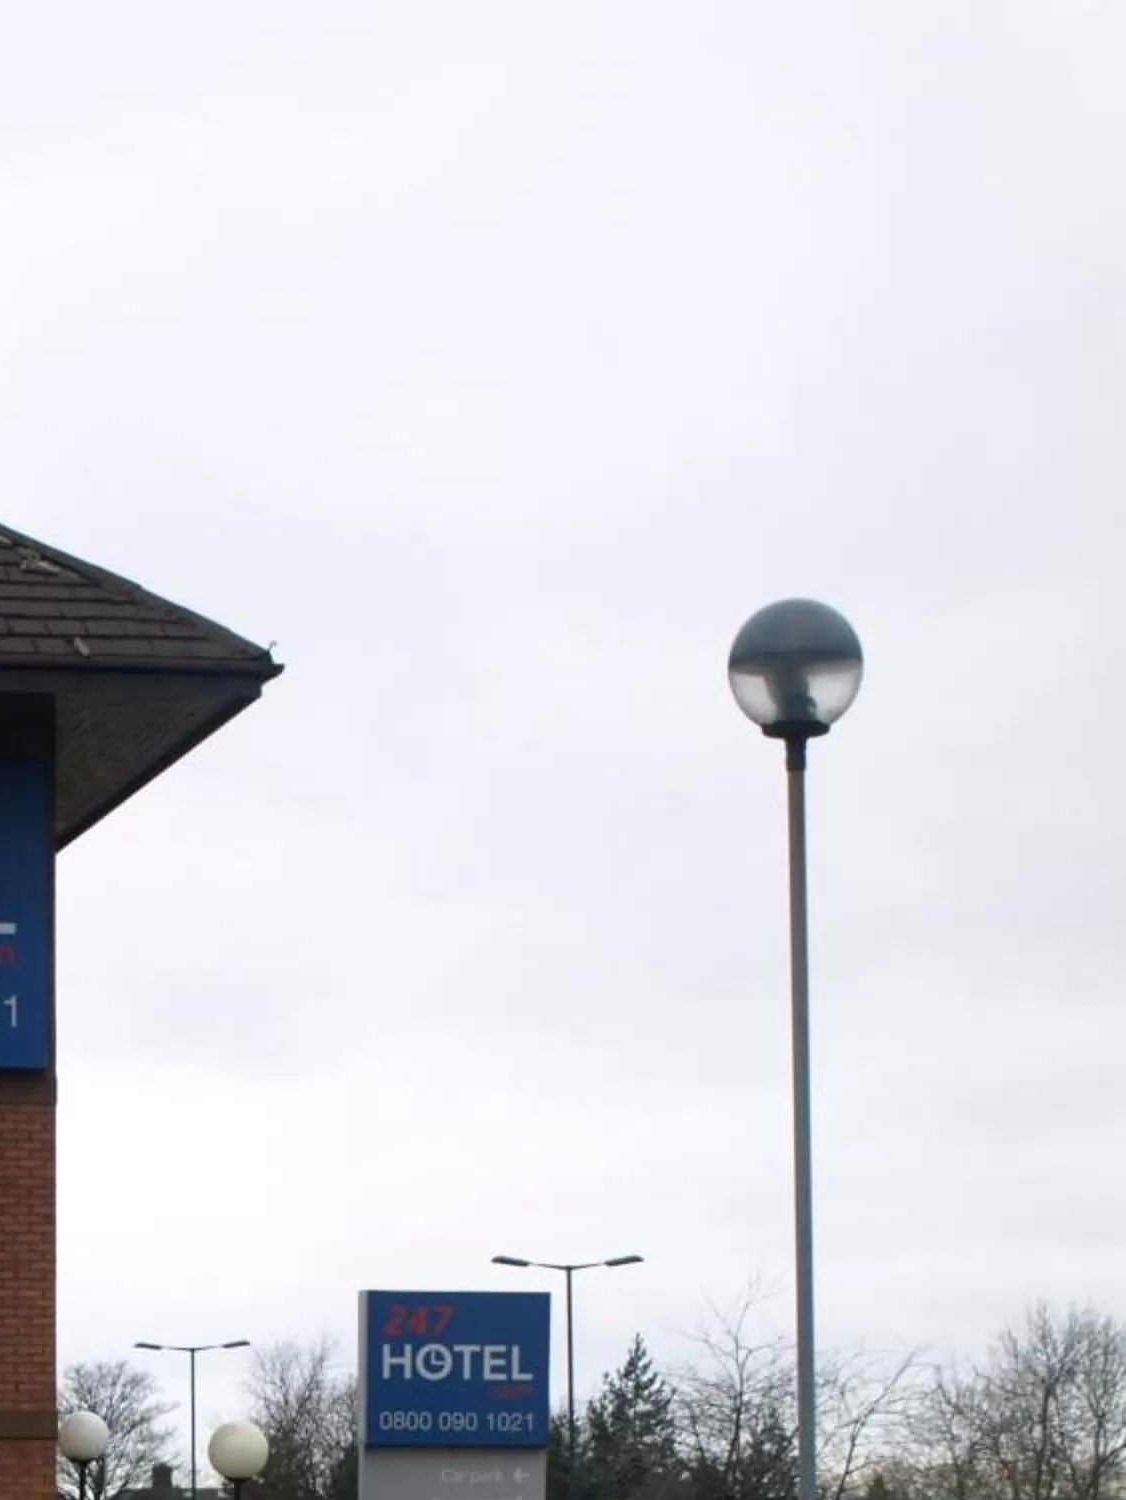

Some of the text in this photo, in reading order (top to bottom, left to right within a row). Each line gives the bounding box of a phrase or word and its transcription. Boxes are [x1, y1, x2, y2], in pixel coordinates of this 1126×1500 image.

[384, 1303, 455, 1336] 247
[382, 1343, 535, 1381] HOTEL
[379, 1411, 534, 1433] 0800 090 1021
